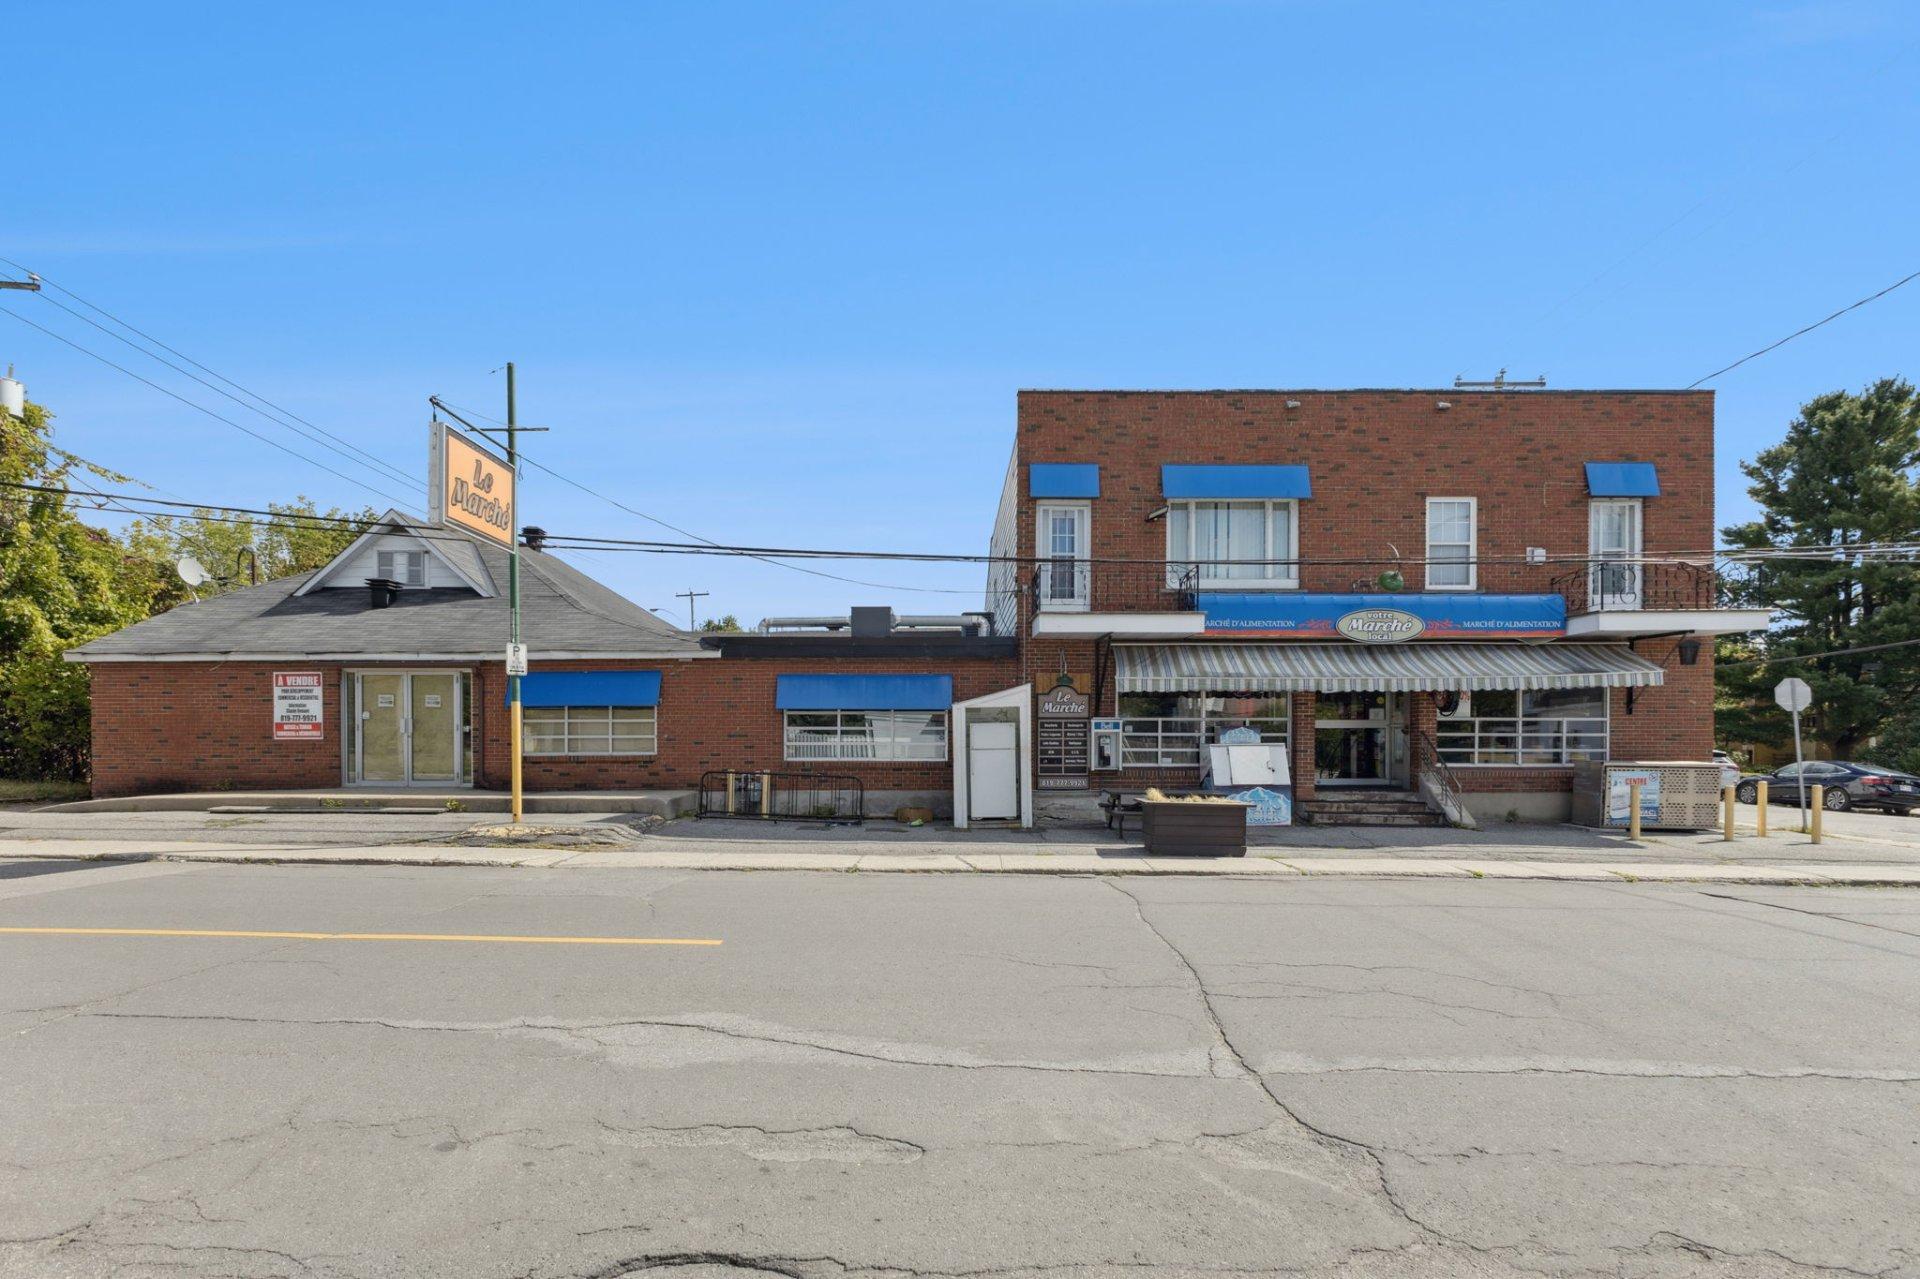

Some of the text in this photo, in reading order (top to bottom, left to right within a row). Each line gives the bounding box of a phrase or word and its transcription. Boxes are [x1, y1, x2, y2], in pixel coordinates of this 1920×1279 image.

[473, 459, 494, 493] Le
[450, 477, 511, 531] Marché
[1204, 619, 1295, 628] ARCHÉ D'ALIMENTATION
[1348, 617, 1412, 632] Marché
[1463, 619, 1560, 628] MARCHÉ D'ALIMENTATION
[1368, 632, 1392, 640] local
[286, 675, 320, 686] VENDRE
[1056, 691, 1071, 702] Le
[1042, 701, 1085, 713] Marché
